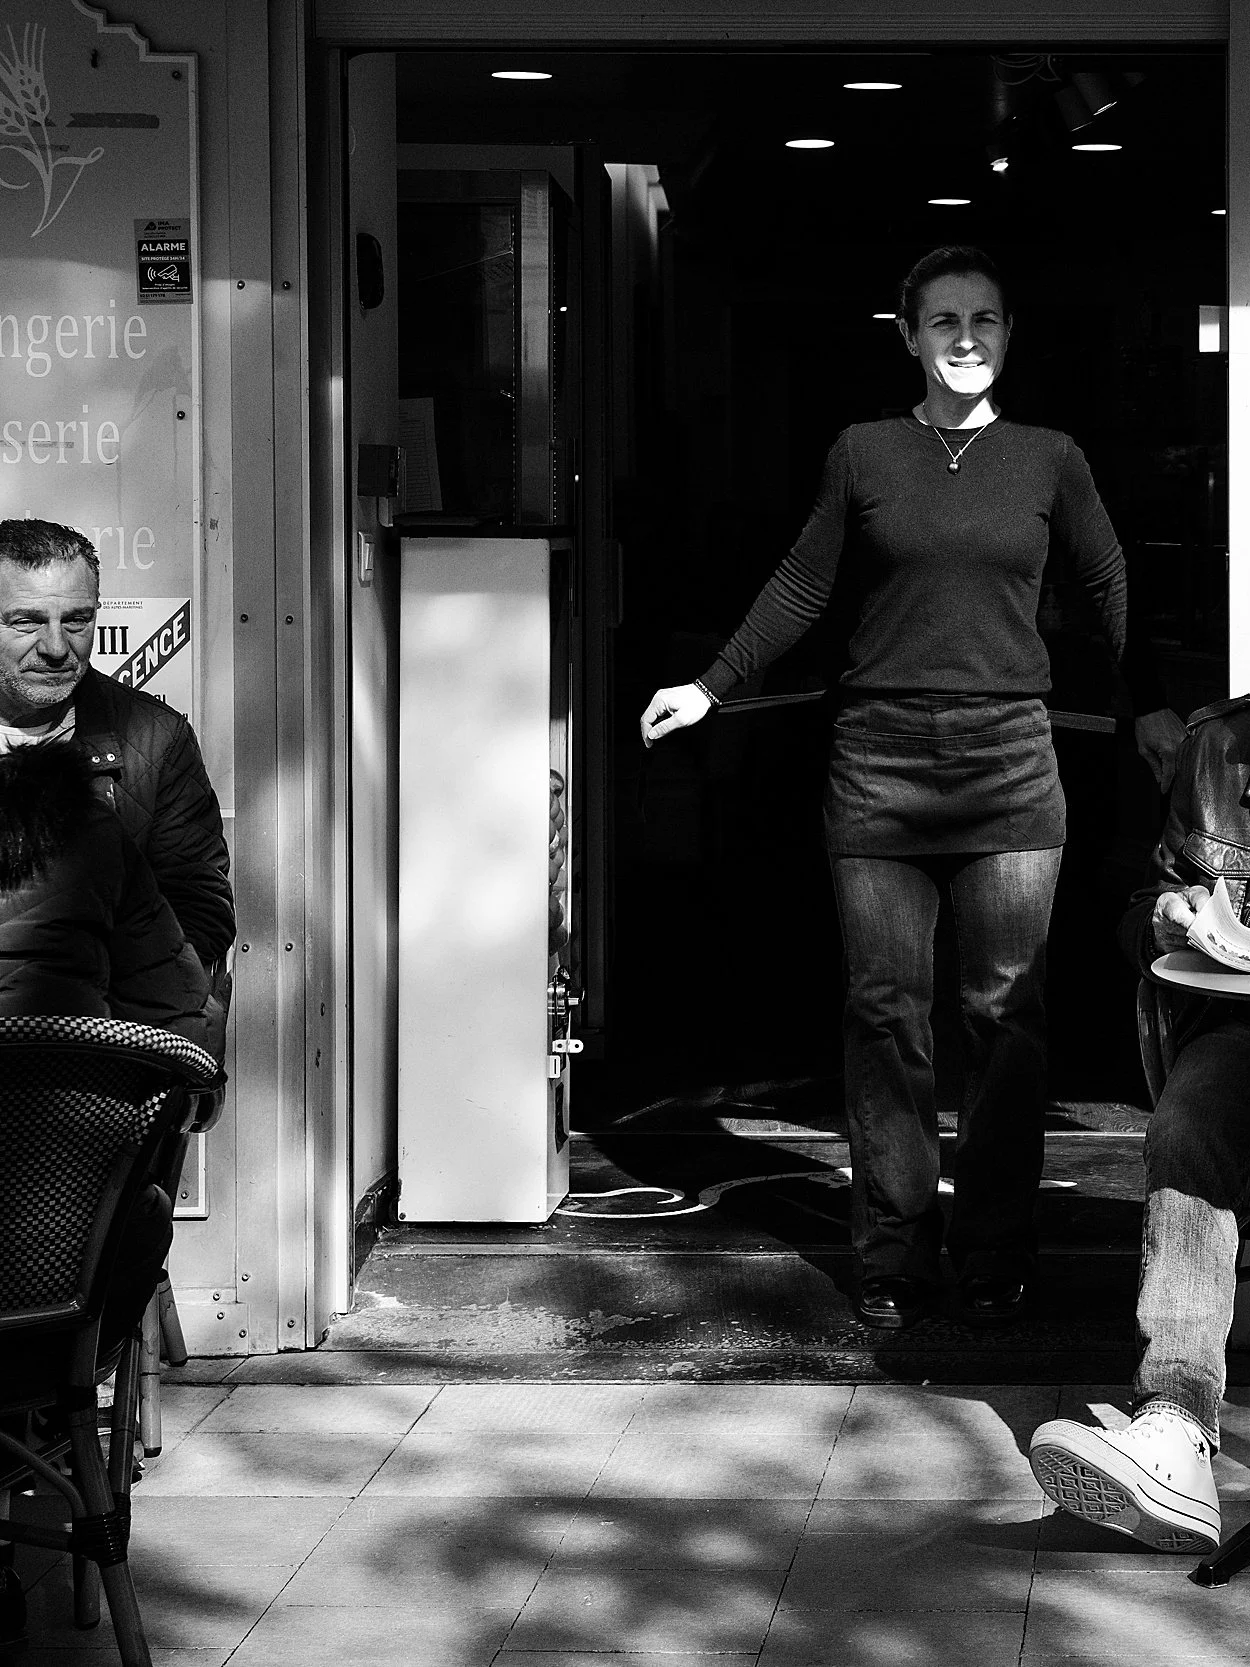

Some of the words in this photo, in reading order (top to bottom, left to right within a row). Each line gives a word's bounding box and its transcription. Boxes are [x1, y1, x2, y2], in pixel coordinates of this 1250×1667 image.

[141, 243, 186, 251] ALARME
[0, 300, 147, 378] ngerie
[97, 626, 129, 654] III
